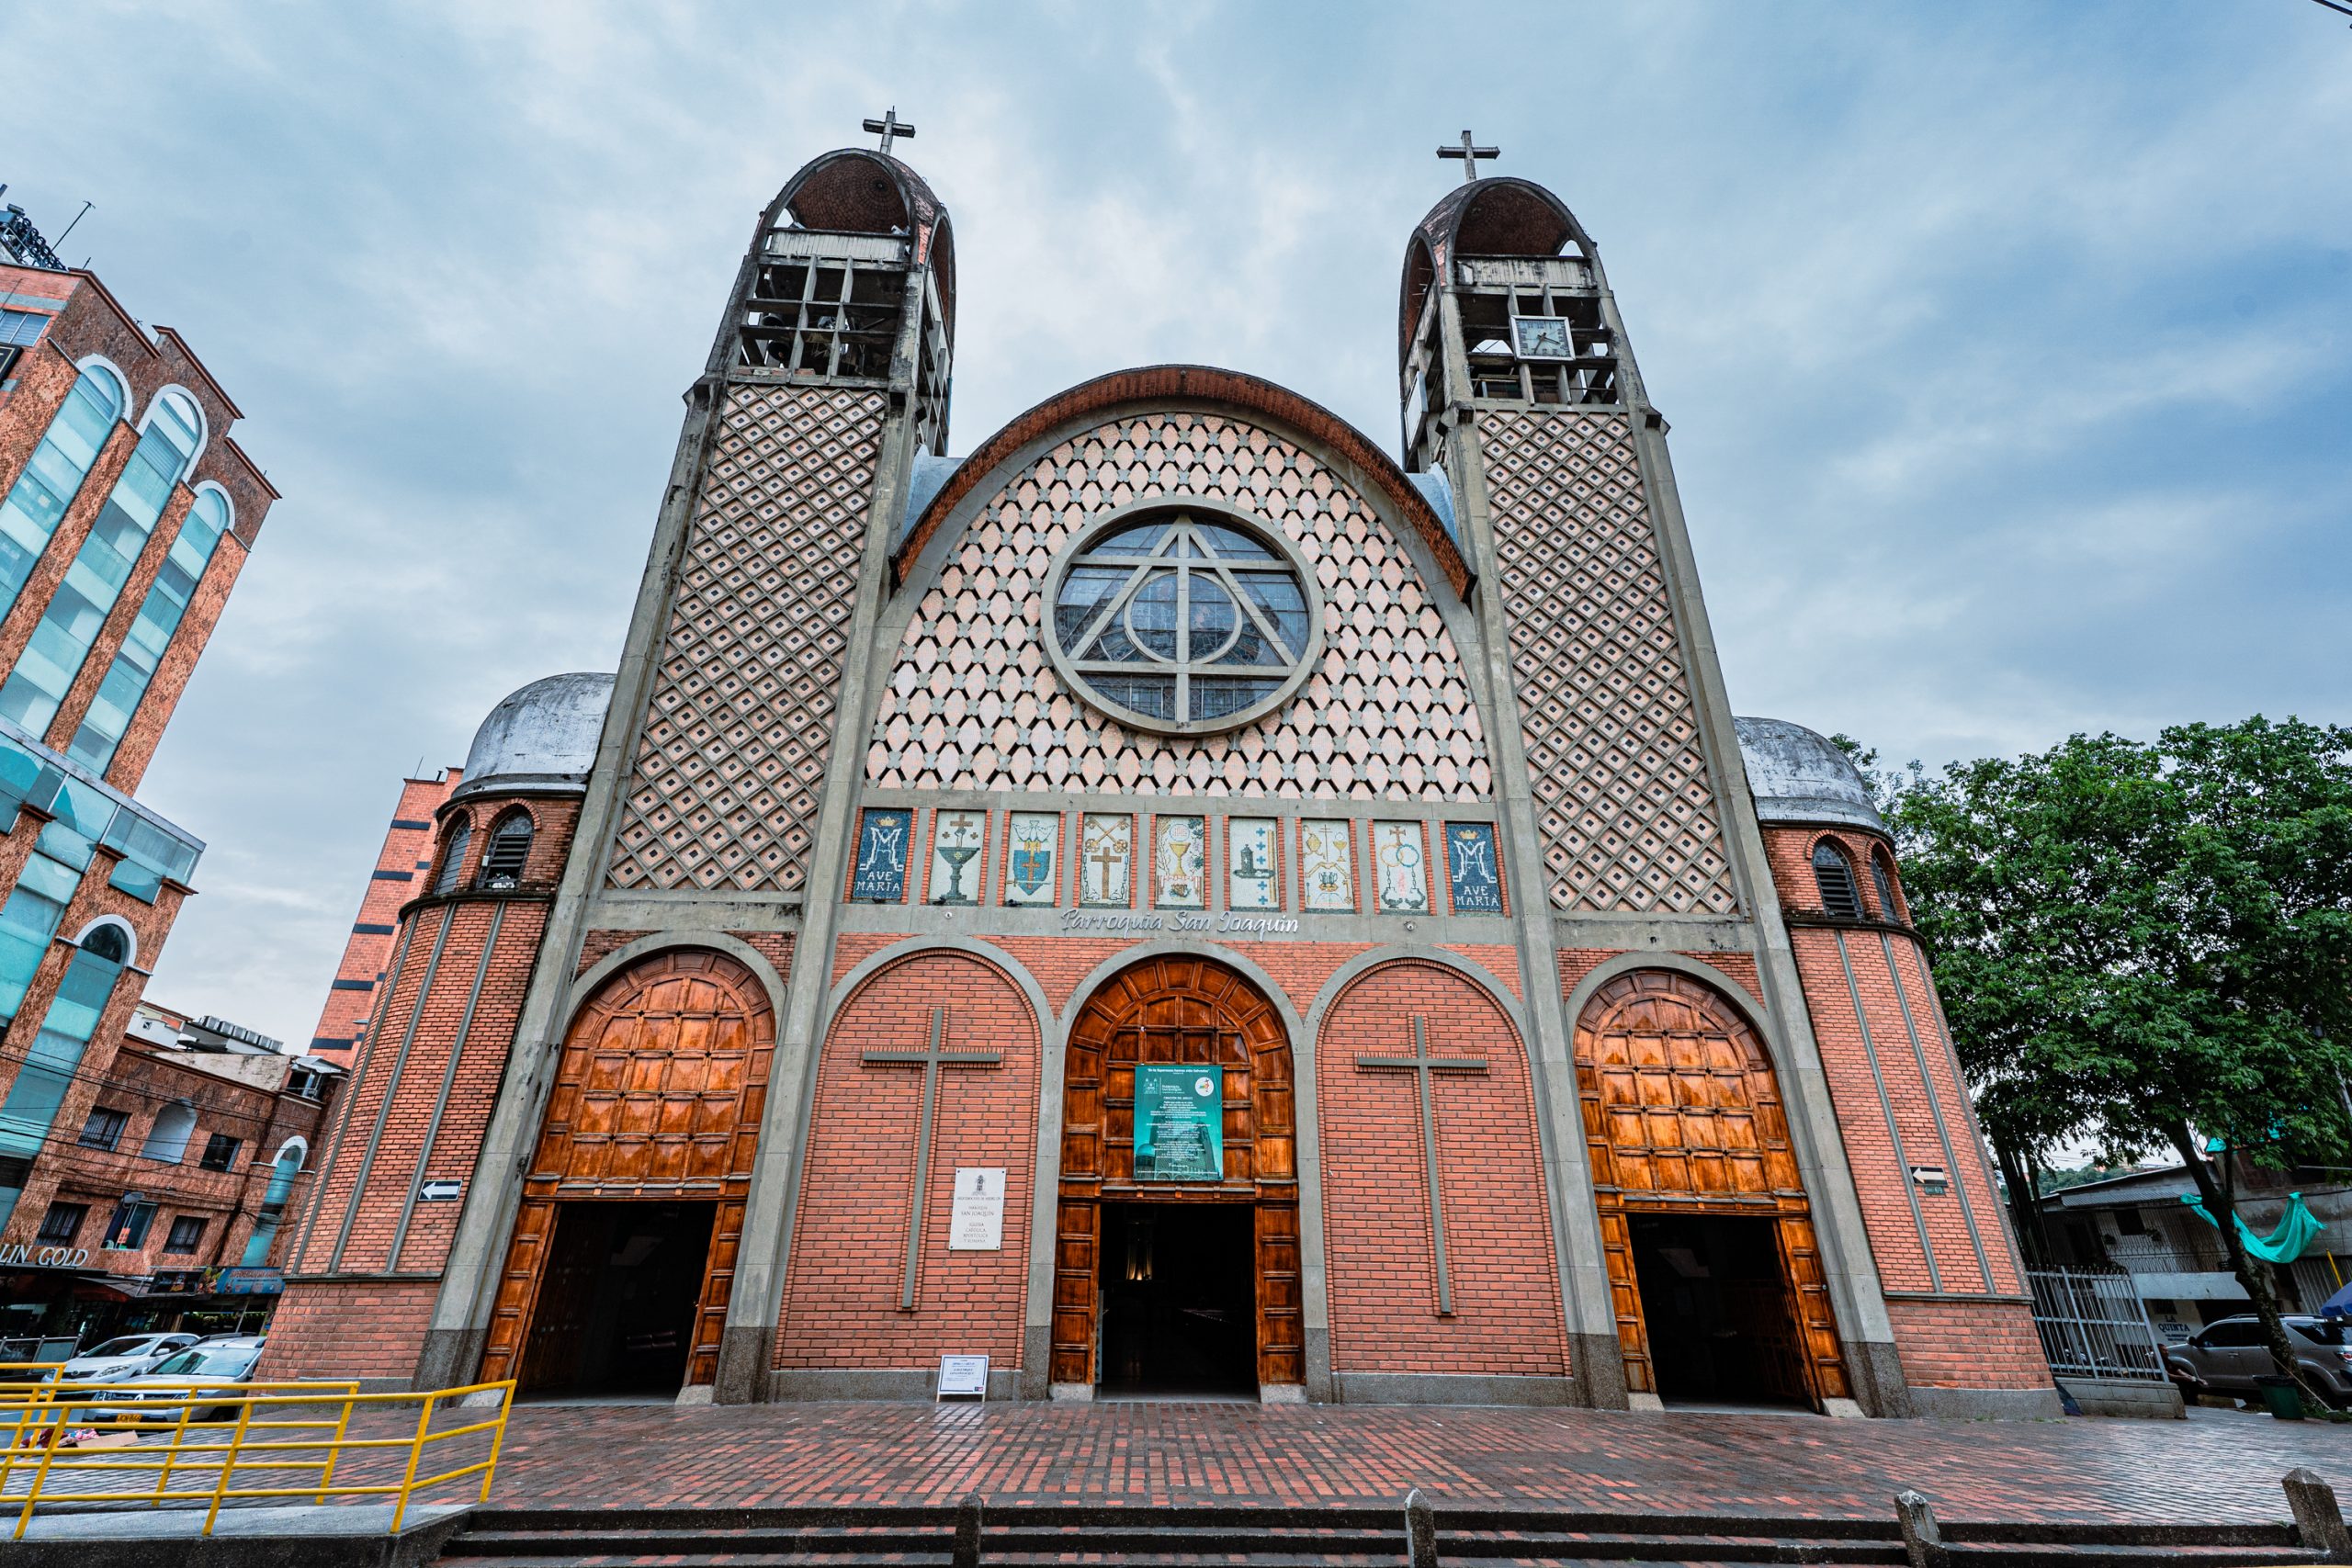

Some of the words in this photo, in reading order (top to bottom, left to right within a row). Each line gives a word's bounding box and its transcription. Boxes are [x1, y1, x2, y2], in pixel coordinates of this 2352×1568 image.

[866, 871, 893, 881] AVE
[856, 881, 900, 892] MARIA
[1464, 886, 1488, 896] AVE
[1060, 908, 1162, 940] Parroquia
[1169, 911, 1211, 931] San
[38, 1247, 88, 1267] GOLD
[2158, 1323, 2190, 1333] QUINTA
